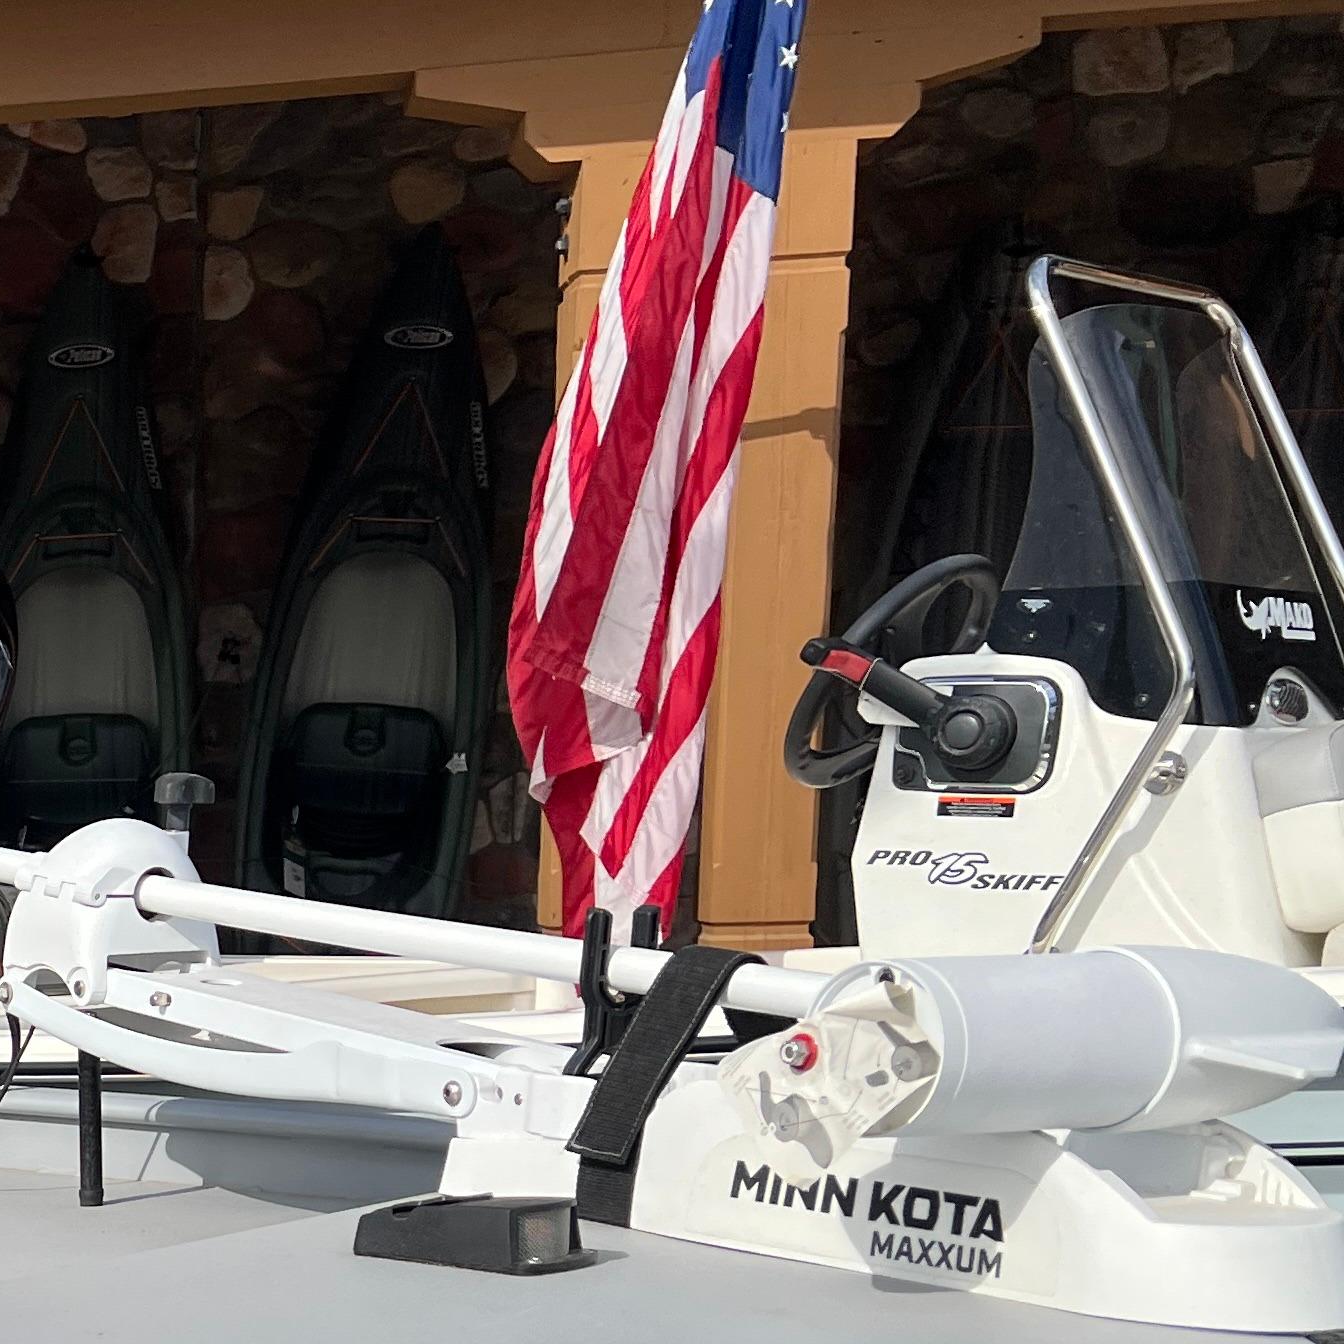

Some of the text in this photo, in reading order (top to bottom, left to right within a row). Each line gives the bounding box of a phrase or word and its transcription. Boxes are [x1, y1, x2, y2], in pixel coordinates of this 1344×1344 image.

[867, 850, 1065, 891] PRO 15 SKIFF
[730, 1160, 1005, 1243] MINN KOTA
[870, 1230, 1003, 1279] MAXXUM
